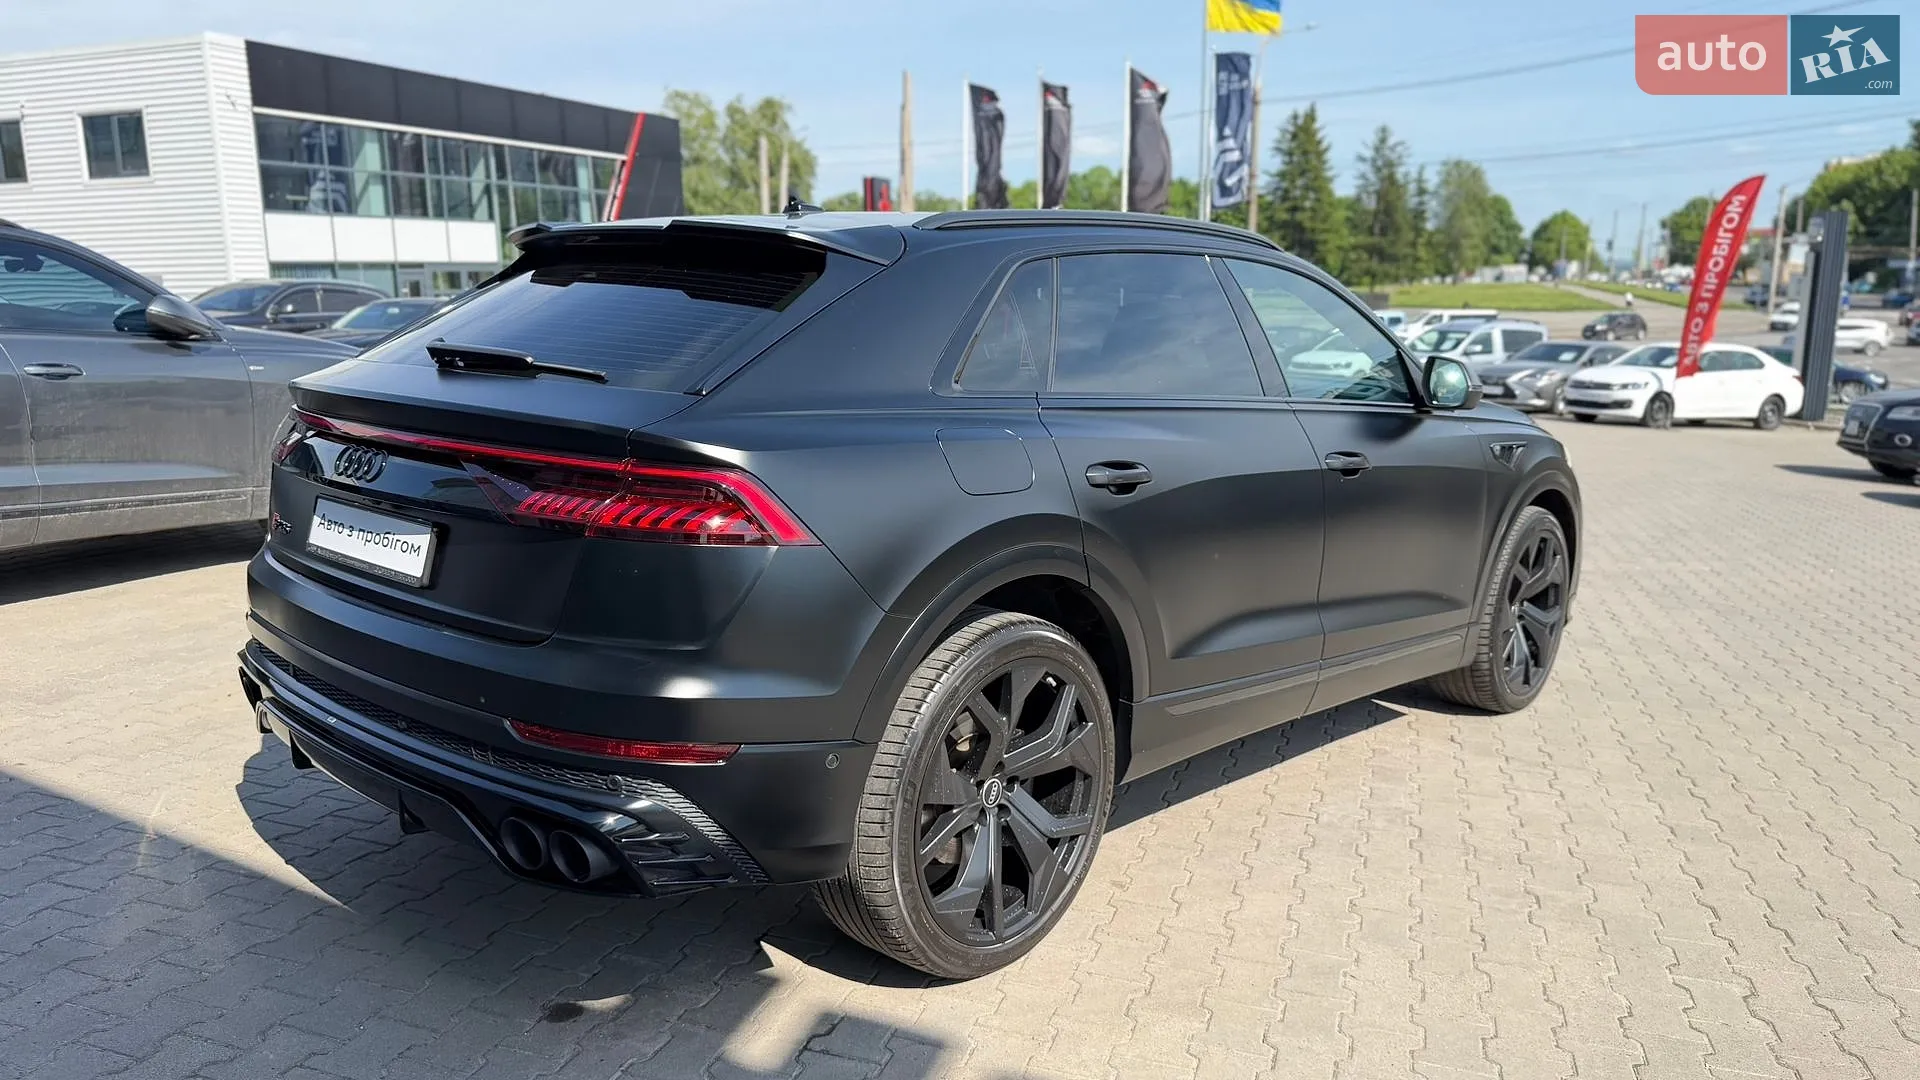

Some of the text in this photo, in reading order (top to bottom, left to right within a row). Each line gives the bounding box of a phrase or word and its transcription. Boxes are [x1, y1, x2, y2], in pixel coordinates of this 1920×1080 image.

[1683, 194, 1748, 366] АВТО З ПРОБІГОМ
[318, 513, 345, 535] Авто
[346, 525, 355, 537] з
[357, 528, 422, 557] пробігом
